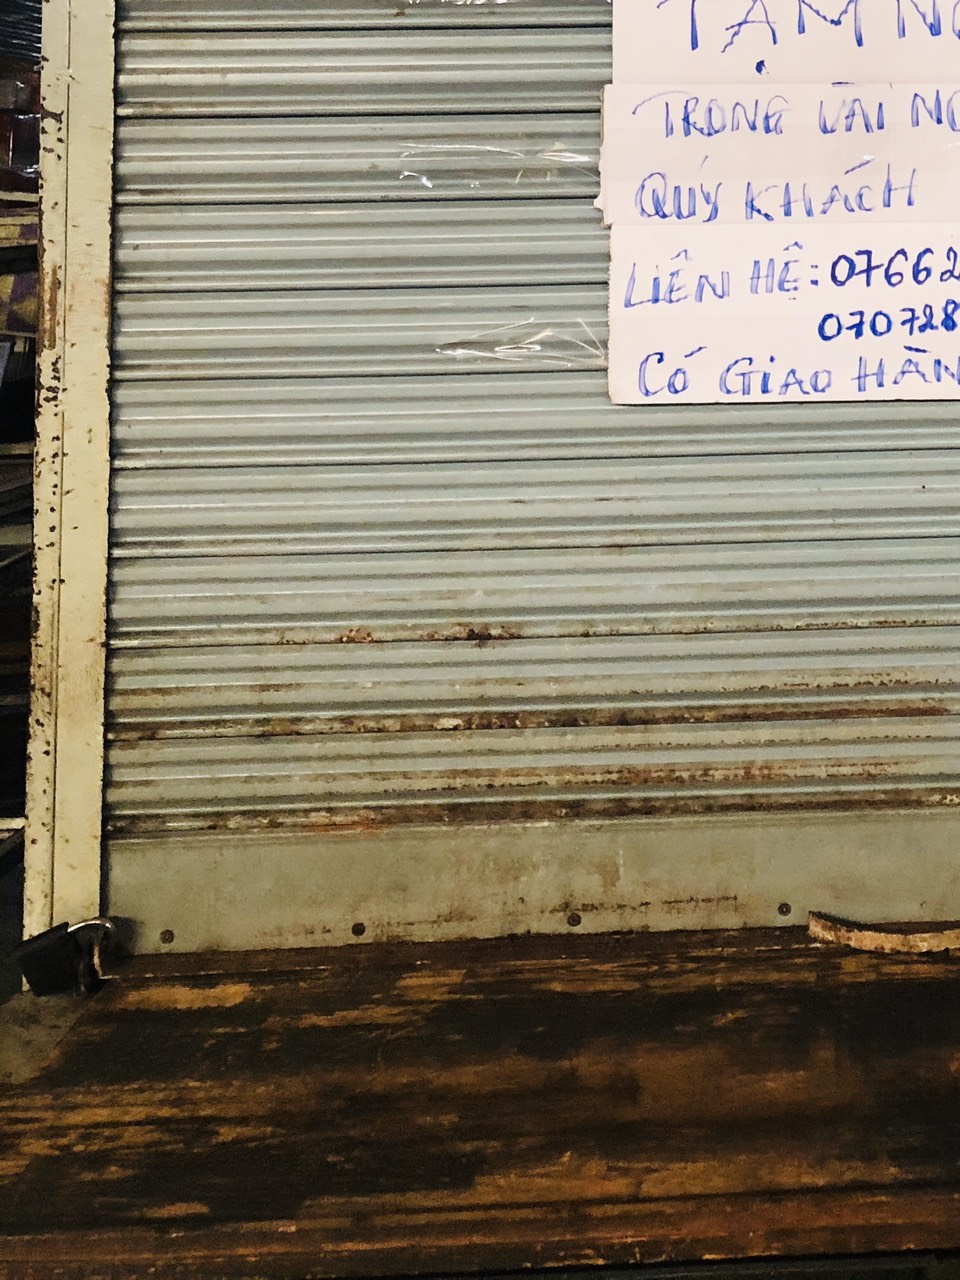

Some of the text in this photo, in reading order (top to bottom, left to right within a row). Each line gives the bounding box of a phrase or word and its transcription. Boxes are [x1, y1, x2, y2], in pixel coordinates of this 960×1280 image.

[631, 90, 792, 138] TRONG
[634, 154, 918, 222] QUÝ KHÁCH
